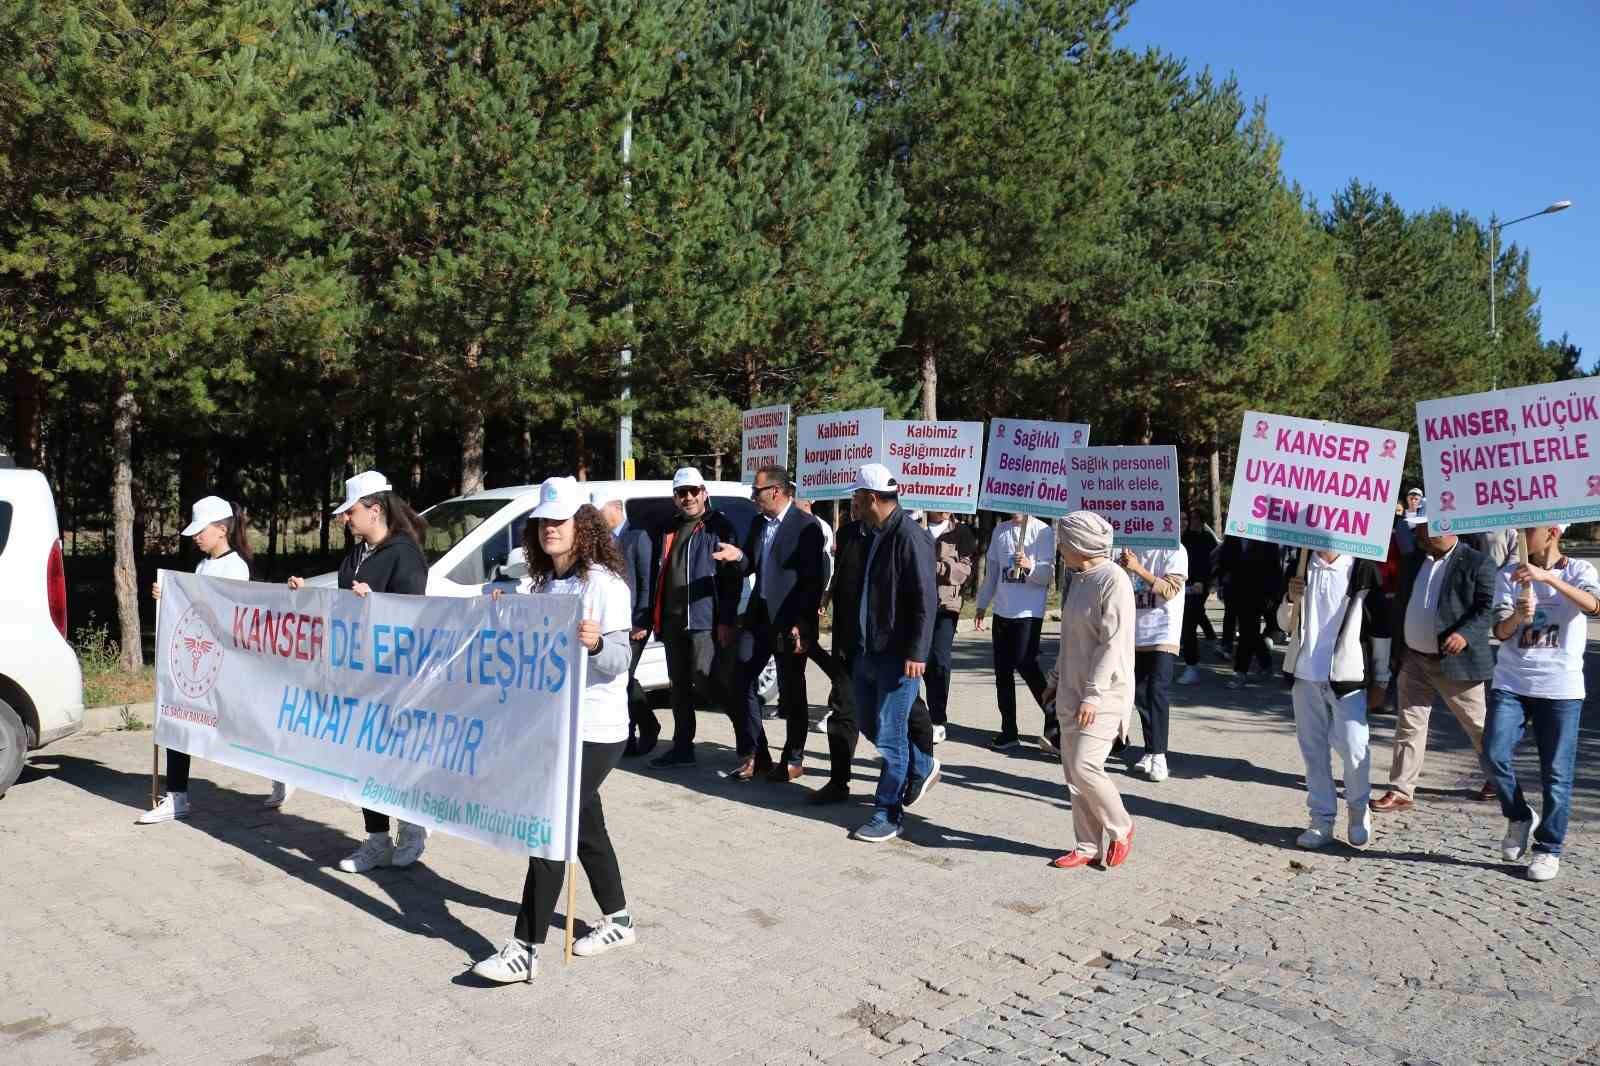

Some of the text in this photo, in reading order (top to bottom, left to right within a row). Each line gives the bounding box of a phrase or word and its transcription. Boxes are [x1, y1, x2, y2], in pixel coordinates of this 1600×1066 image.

[1425, 392, 1599, 442] KANSER, KÜÇÜK
[817, 420, 859, 440] Kalbinizi
[907, 424, 958, 439] Kalbimiz
[1013, 428, 1060, 451] Sağlıklı
[804, 443, 873, 464] koruyun içinde
[889, 443, 966, 460] Sağlığımızdır
[1275, 428, 1370, 464] KANSER
[999, 453, 1067, 475] Beslenmek
[1071, 455, 1170, 473] Sağlık personeli
[1440, 433, 1590, 482] ŞİKAYETLERLE
[901, 463, 957, 476] Kalbimiz
[896, 482, 964, 497] ayatımızdır
[985, 476, 1068, 502] Kanseri Önle
[1081, 477, 1163, 492] ve halk elele,
[1246, 458, 1390, 504] UYANMADAN
[1475, 474, 1558, 510] BAŞLAR
[1080, 496, 1127, 511] kanser
[1130, 500, 1165, 511] sana
[1124, 517, 1155, 534] güle
[1251, 494, 1371, 536] SEN UYAN
[232, 605, 323, 661] KANSER
[331, 618, 364, 671] DE
[464, 617, 568, 703] TEŞHİS
[277, 685, 484, 776] HAYAT KURTARIR
[361, 776, 409, 808] Bayburt
[420, 791, 462, 823] Sağlık
[464, 801, 552, 848] Müdürlüğü
